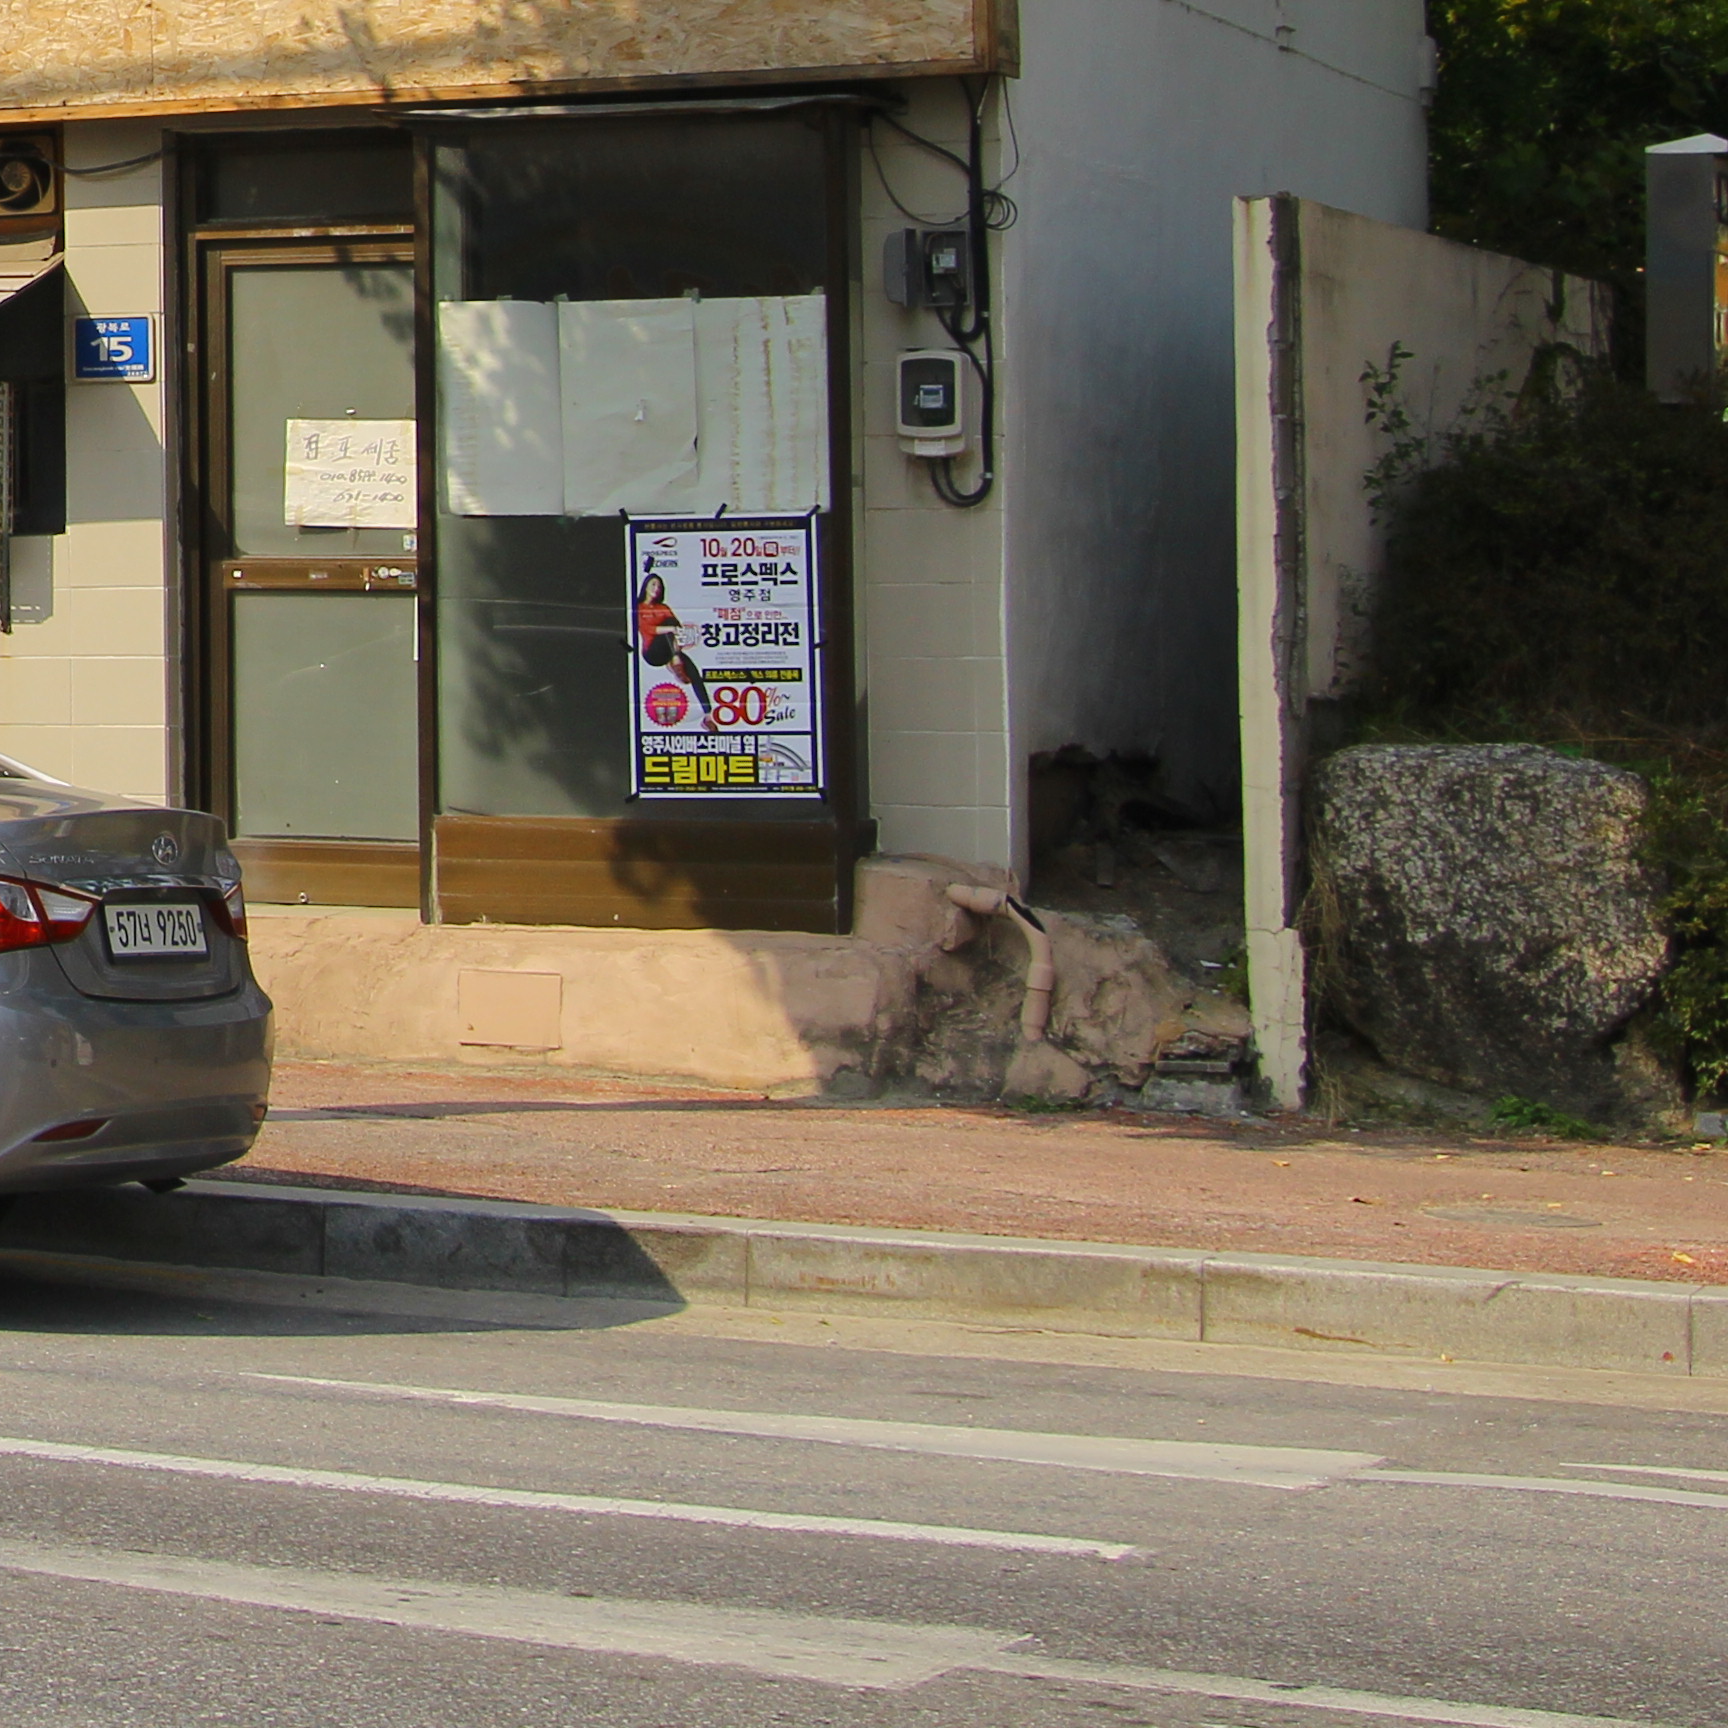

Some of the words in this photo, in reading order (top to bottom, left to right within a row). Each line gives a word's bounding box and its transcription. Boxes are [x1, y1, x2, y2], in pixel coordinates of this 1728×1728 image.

[90, 336, 134, 362] 15
[701, 562, 799, 586] 프로스펙스
[728, 588, 772, 603] 영주점
[701, 621, 800, 648] 창고정리전
[763, 705, 796, 725] Sale
[641, 735, 742, 754] 영주시외버스터미널
[743, 735, 756, 754] 옆
[644, 756, 755, 784] 드림마트
[116, 910, 153, 948] 57너
[156, 909, 197, 947] 9250
